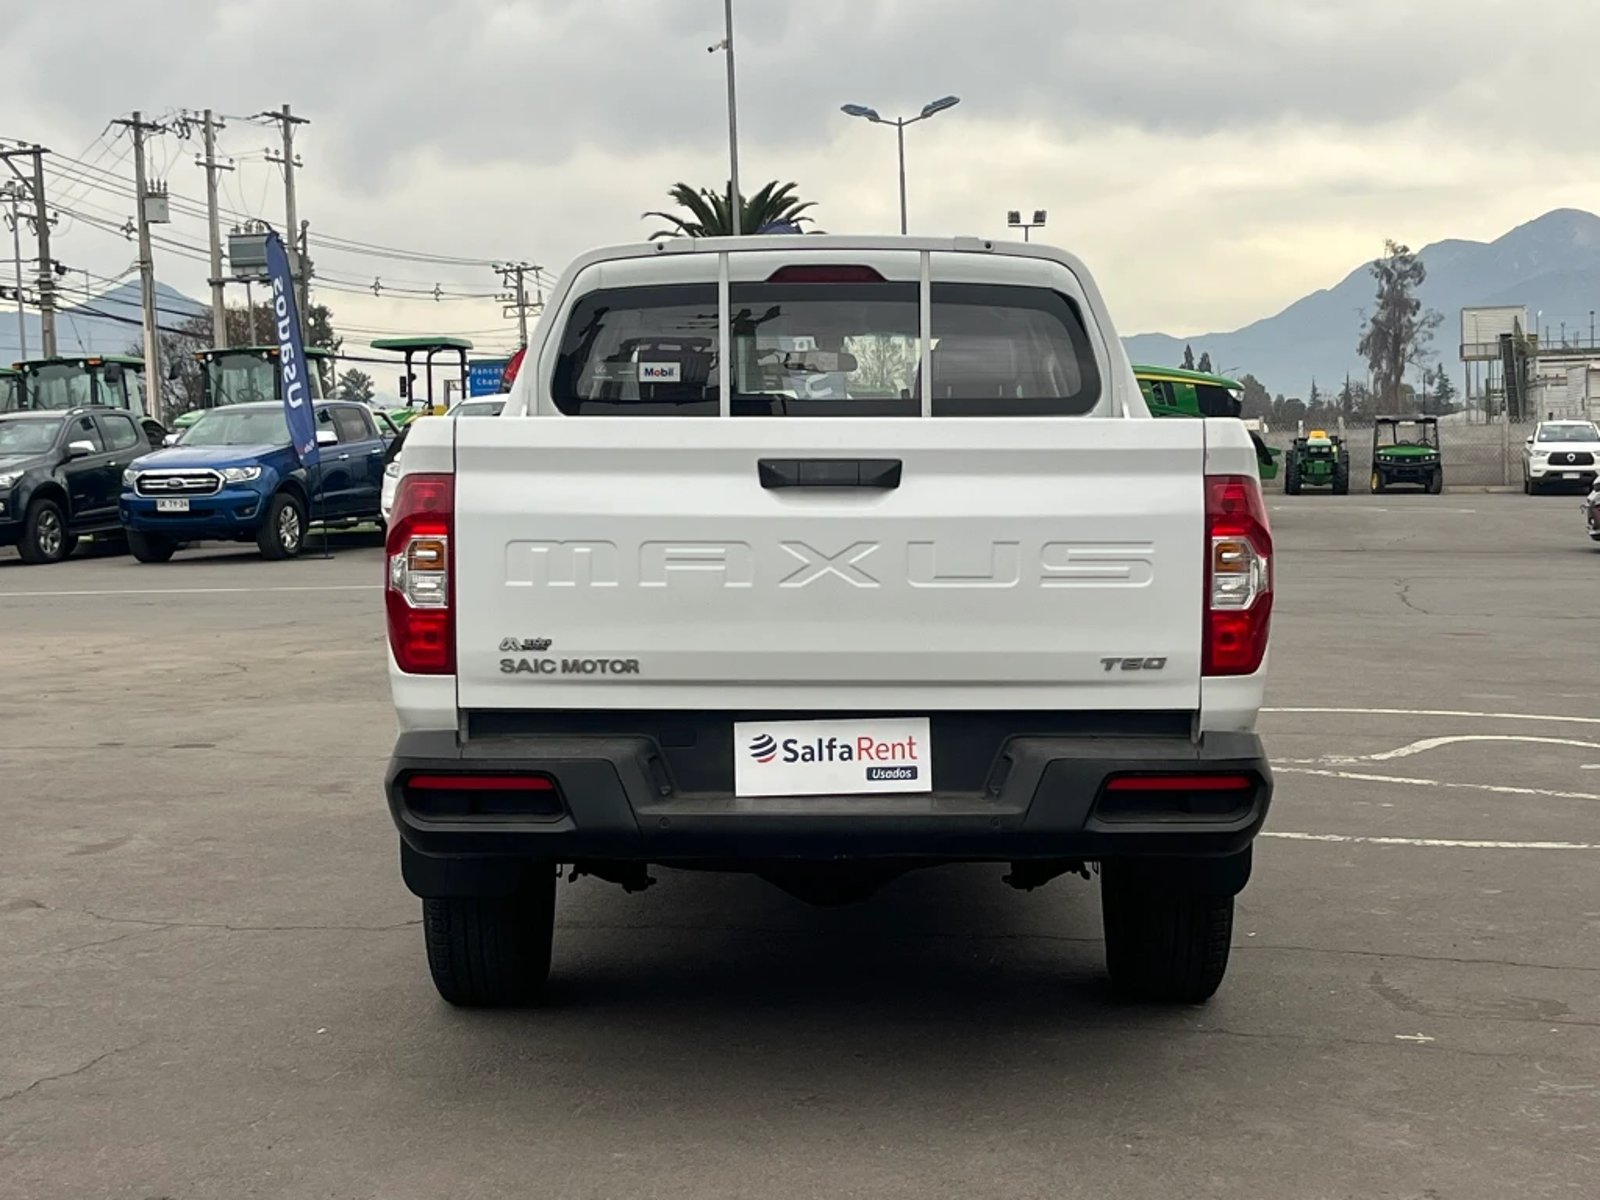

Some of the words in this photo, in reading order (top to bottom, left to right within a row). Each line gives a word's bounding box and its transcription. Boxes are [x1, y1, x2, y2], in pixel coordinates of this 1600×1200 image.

[644, 367, 675, 377] Mobil
[505, 538, 1156, 589] MAXUS
[499, 658, 557, 674] SAIC
[561, 658, 640, 674] MOTOR
[1100, 656, 1168, 671] T60
[782, 735, 918, 763] SalfaRent
[871, 766, 912, 779] Usados
